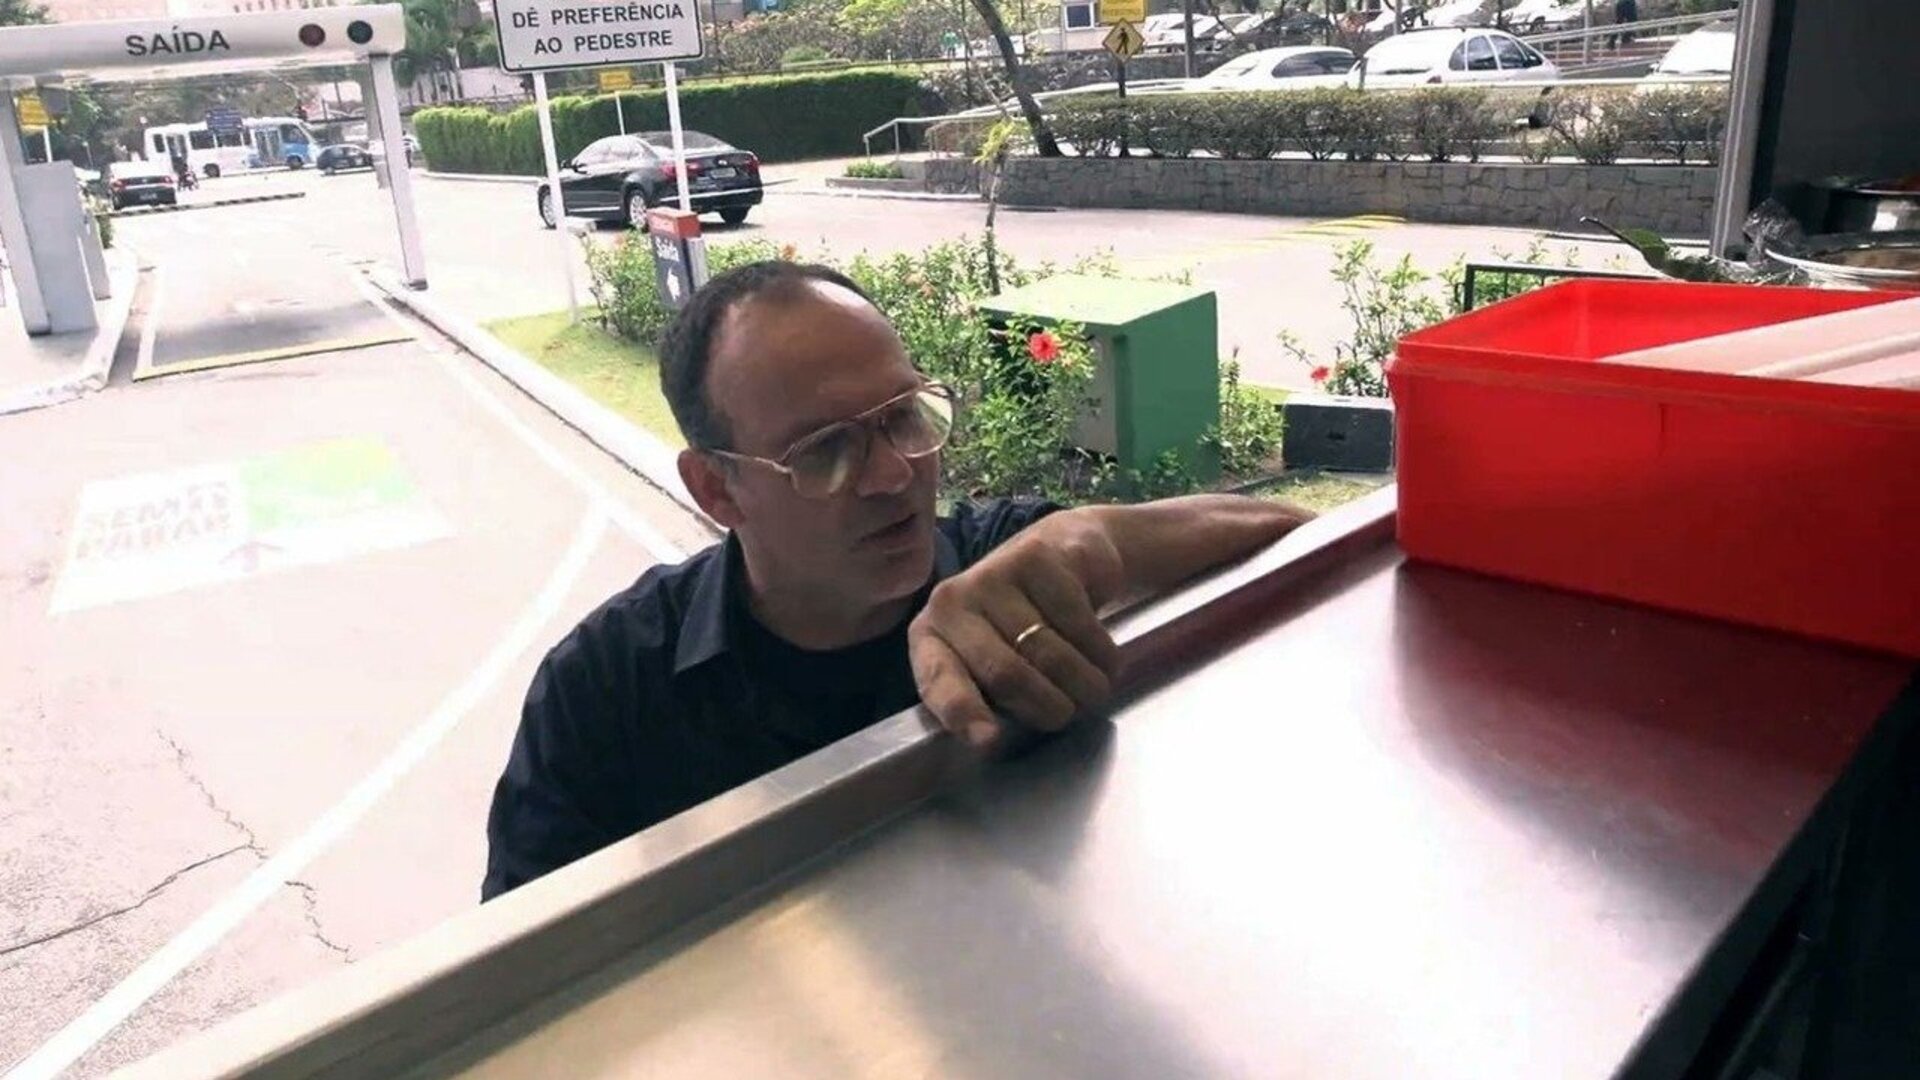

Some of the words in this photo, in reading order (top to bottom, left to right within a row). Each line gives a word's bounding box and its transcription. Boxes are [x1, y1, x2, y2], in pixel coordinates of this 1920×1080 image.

[512, 7, 539, 28] DÊ
[551, 2, 684, 25] PREFERÊNCIA
[125, 25, 231, 56] SAÍDA
[534, 37, 562, 54] AO
[574, 30, 673, 52] PEDESTRE
